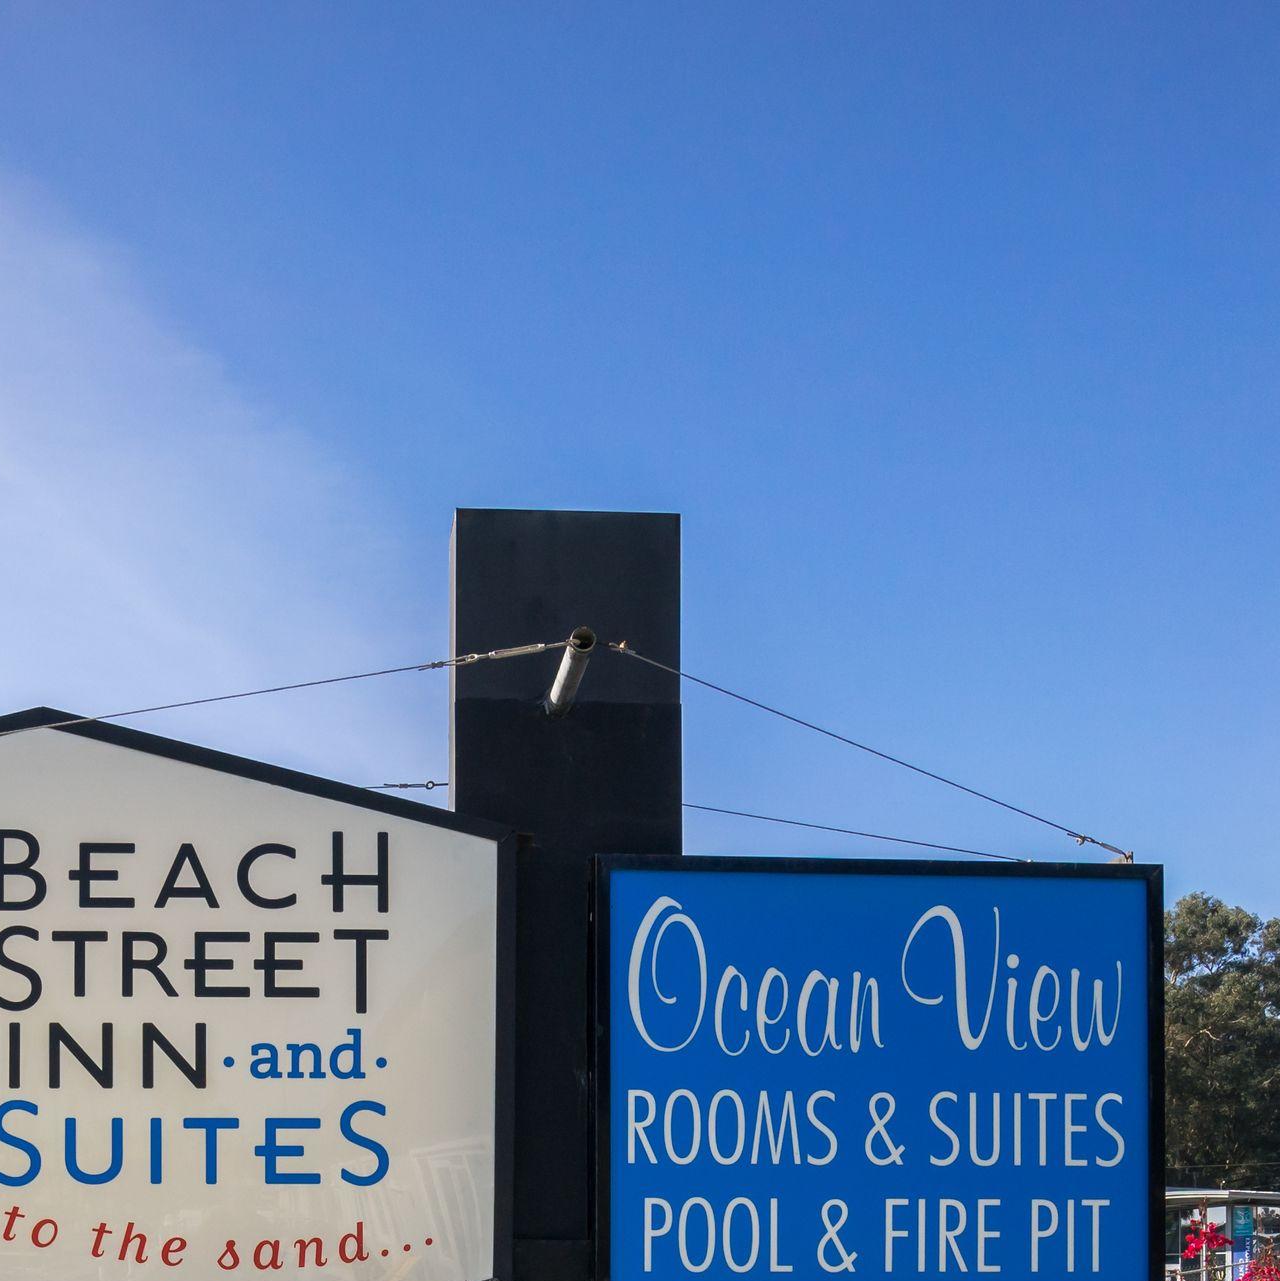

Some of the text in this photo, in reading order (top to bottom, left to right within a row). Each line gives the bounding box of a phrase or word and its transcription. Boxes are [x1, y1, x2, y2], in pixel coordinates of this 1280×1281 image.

[628, 896, 1122, 1057] Ocean View
[9, 1023, 206, 1089] INN
[627, 1089, 1125, 1167] ROOMS & SUITES
[2, 1205, 59, 1249] to
[90, 1222, 188, 1267] the
[644, 1197, 1110, 1273] POOL & FIRE PIT
